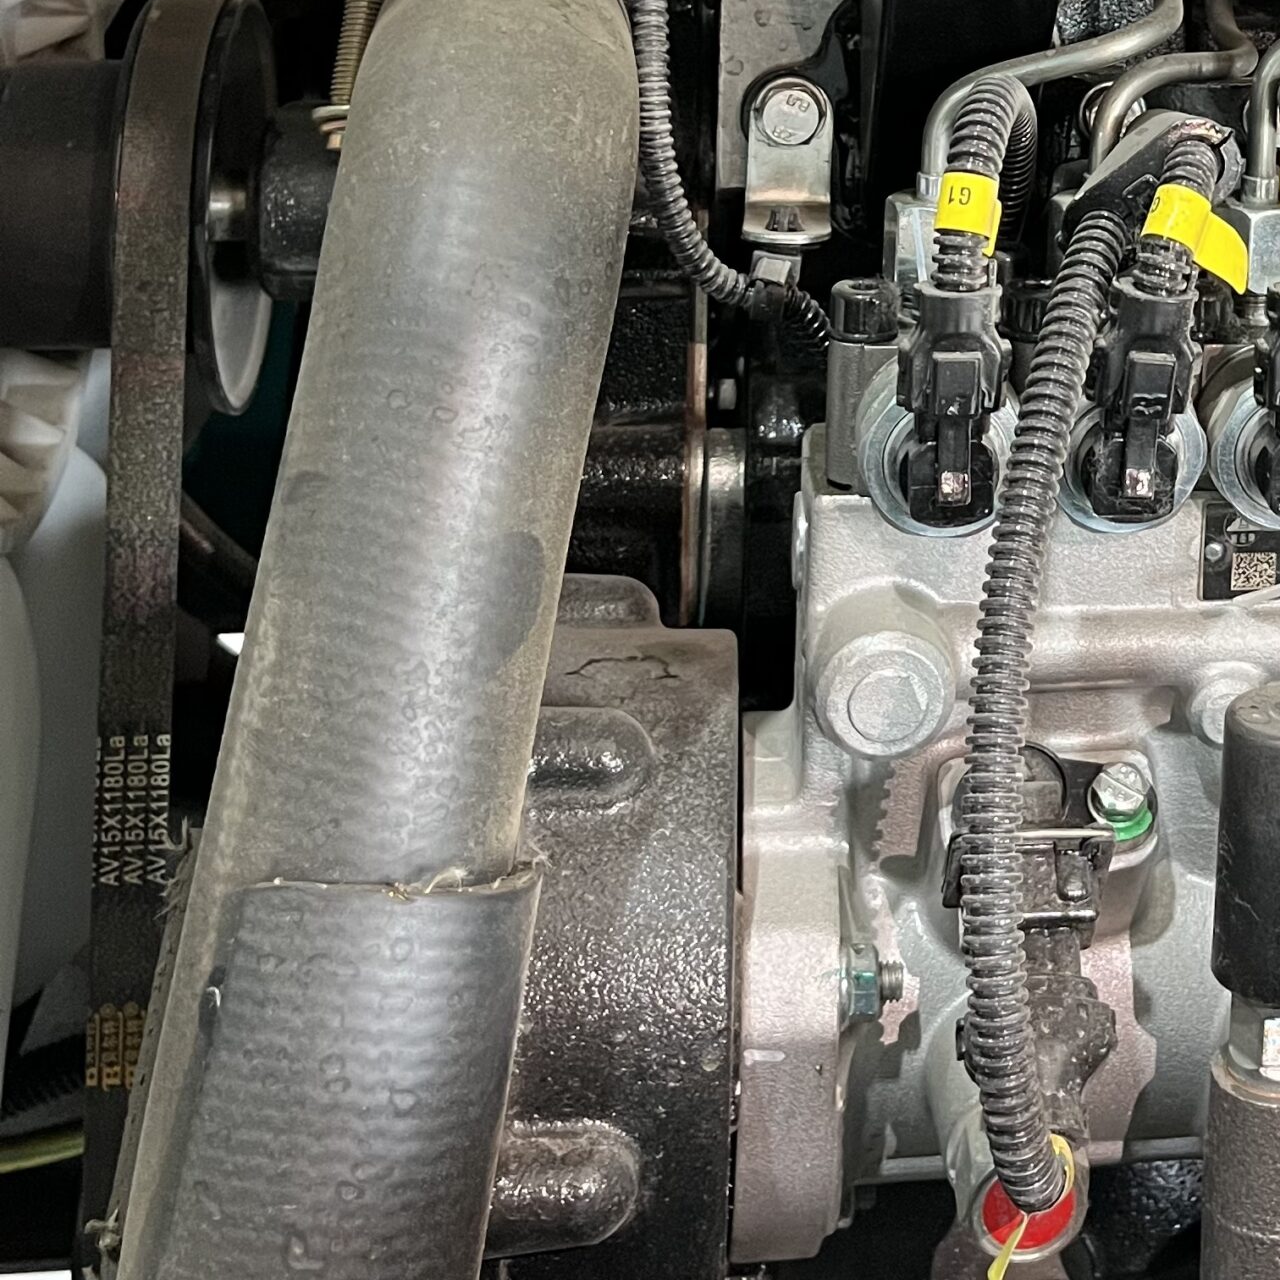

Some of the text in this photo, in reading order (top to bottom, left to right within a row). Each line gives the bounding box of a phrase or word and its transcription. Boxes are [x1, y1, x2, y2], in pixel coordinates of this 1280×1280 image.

[948, 186, 971, 205] G1
[99, 735, 125, 886] AV15X1180La
[123, 735, 148, 885] AV15X1180La
